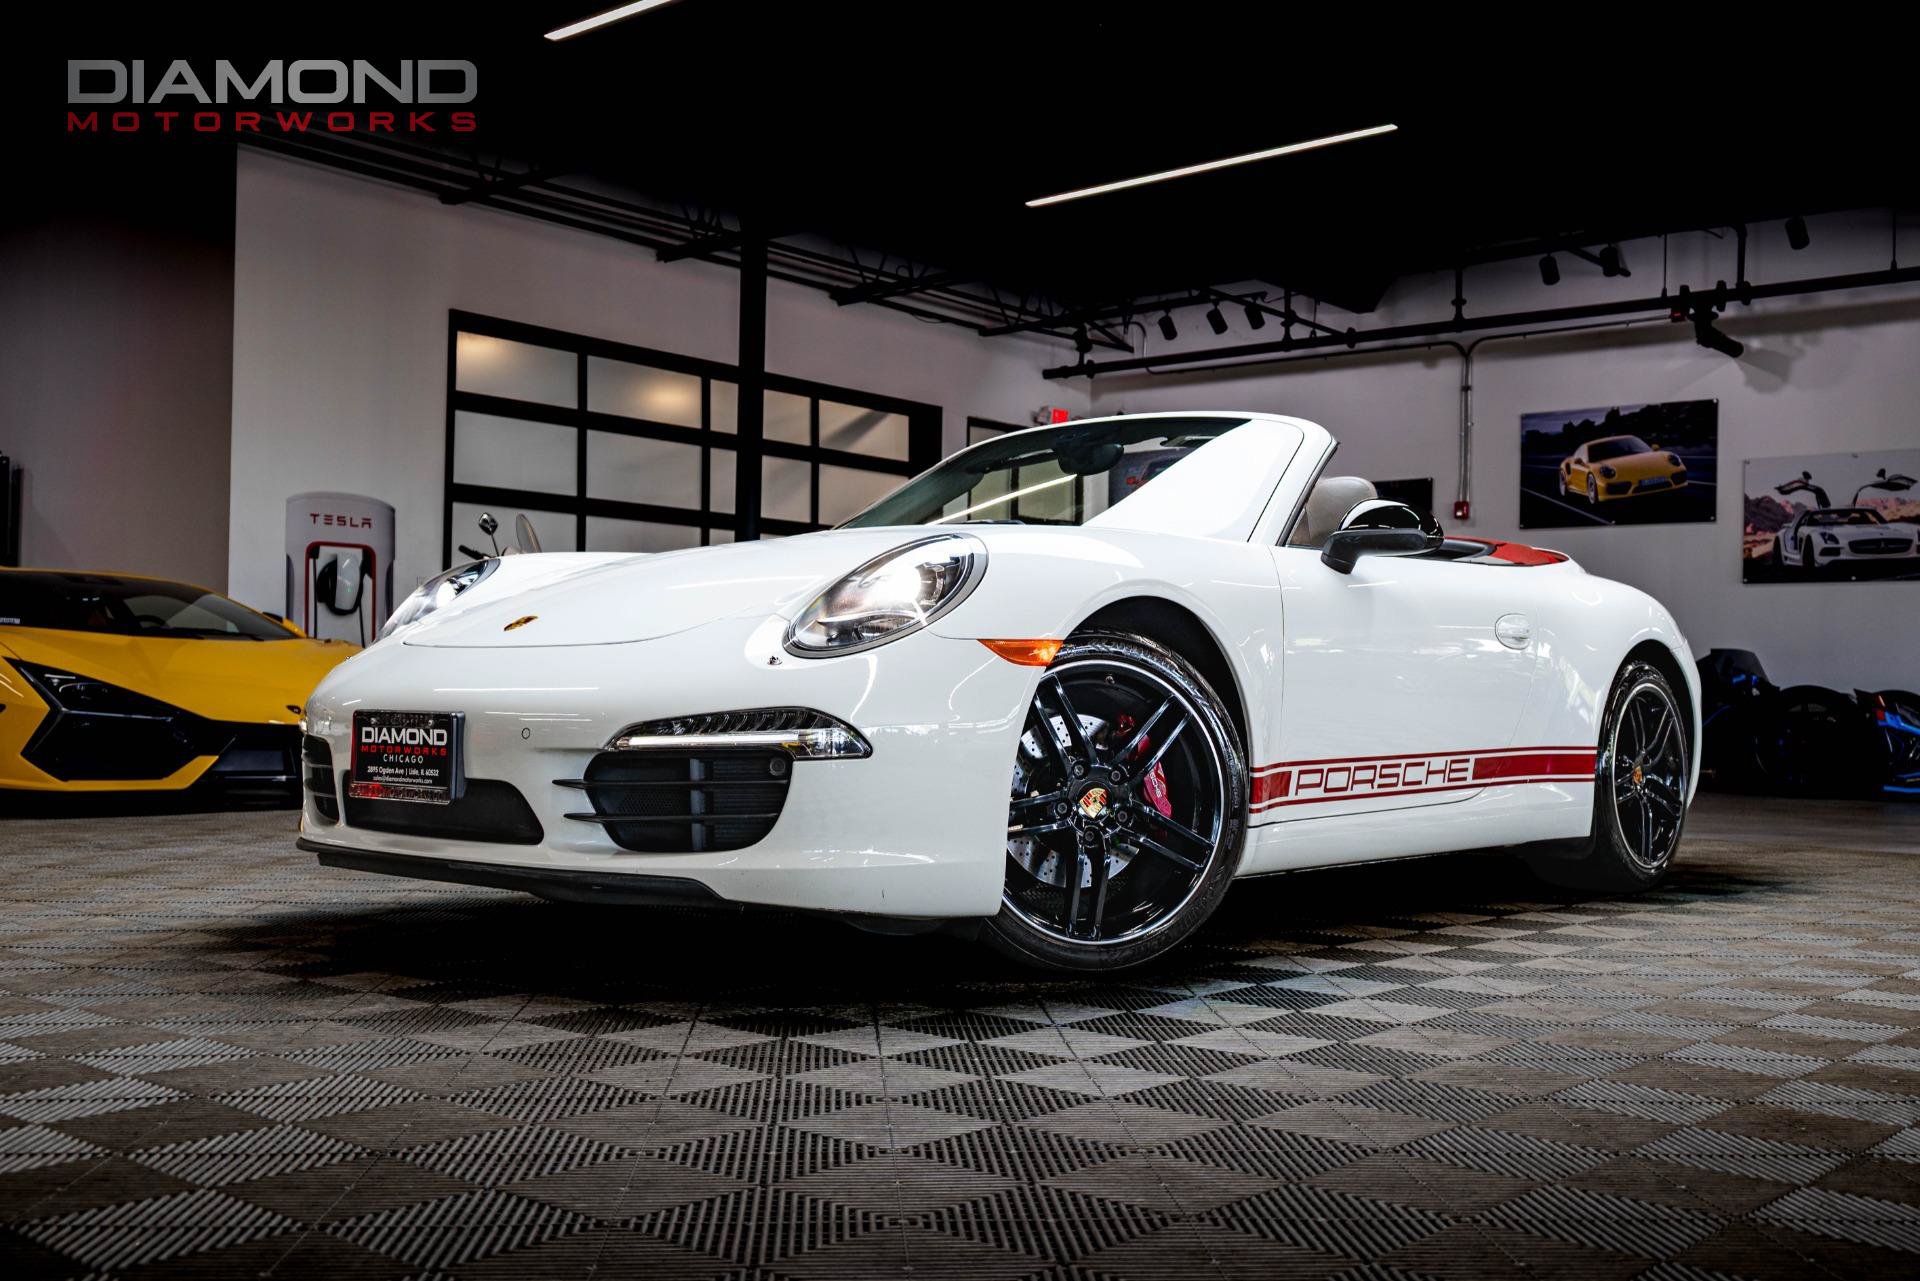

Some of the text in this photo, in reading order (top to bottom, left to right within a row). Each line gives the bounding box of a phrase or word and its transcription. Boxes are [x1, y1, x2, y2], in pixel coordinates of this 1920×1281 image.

[310, 513, 372, 529] TESLA
[361, 726, 448, 746] DIAMOND
[361, 745, 447, 756] MOTORWORKS
[383, 754, 424, 764] CHICAGO
[1295, 758, 1471, 796] PORSCHE
